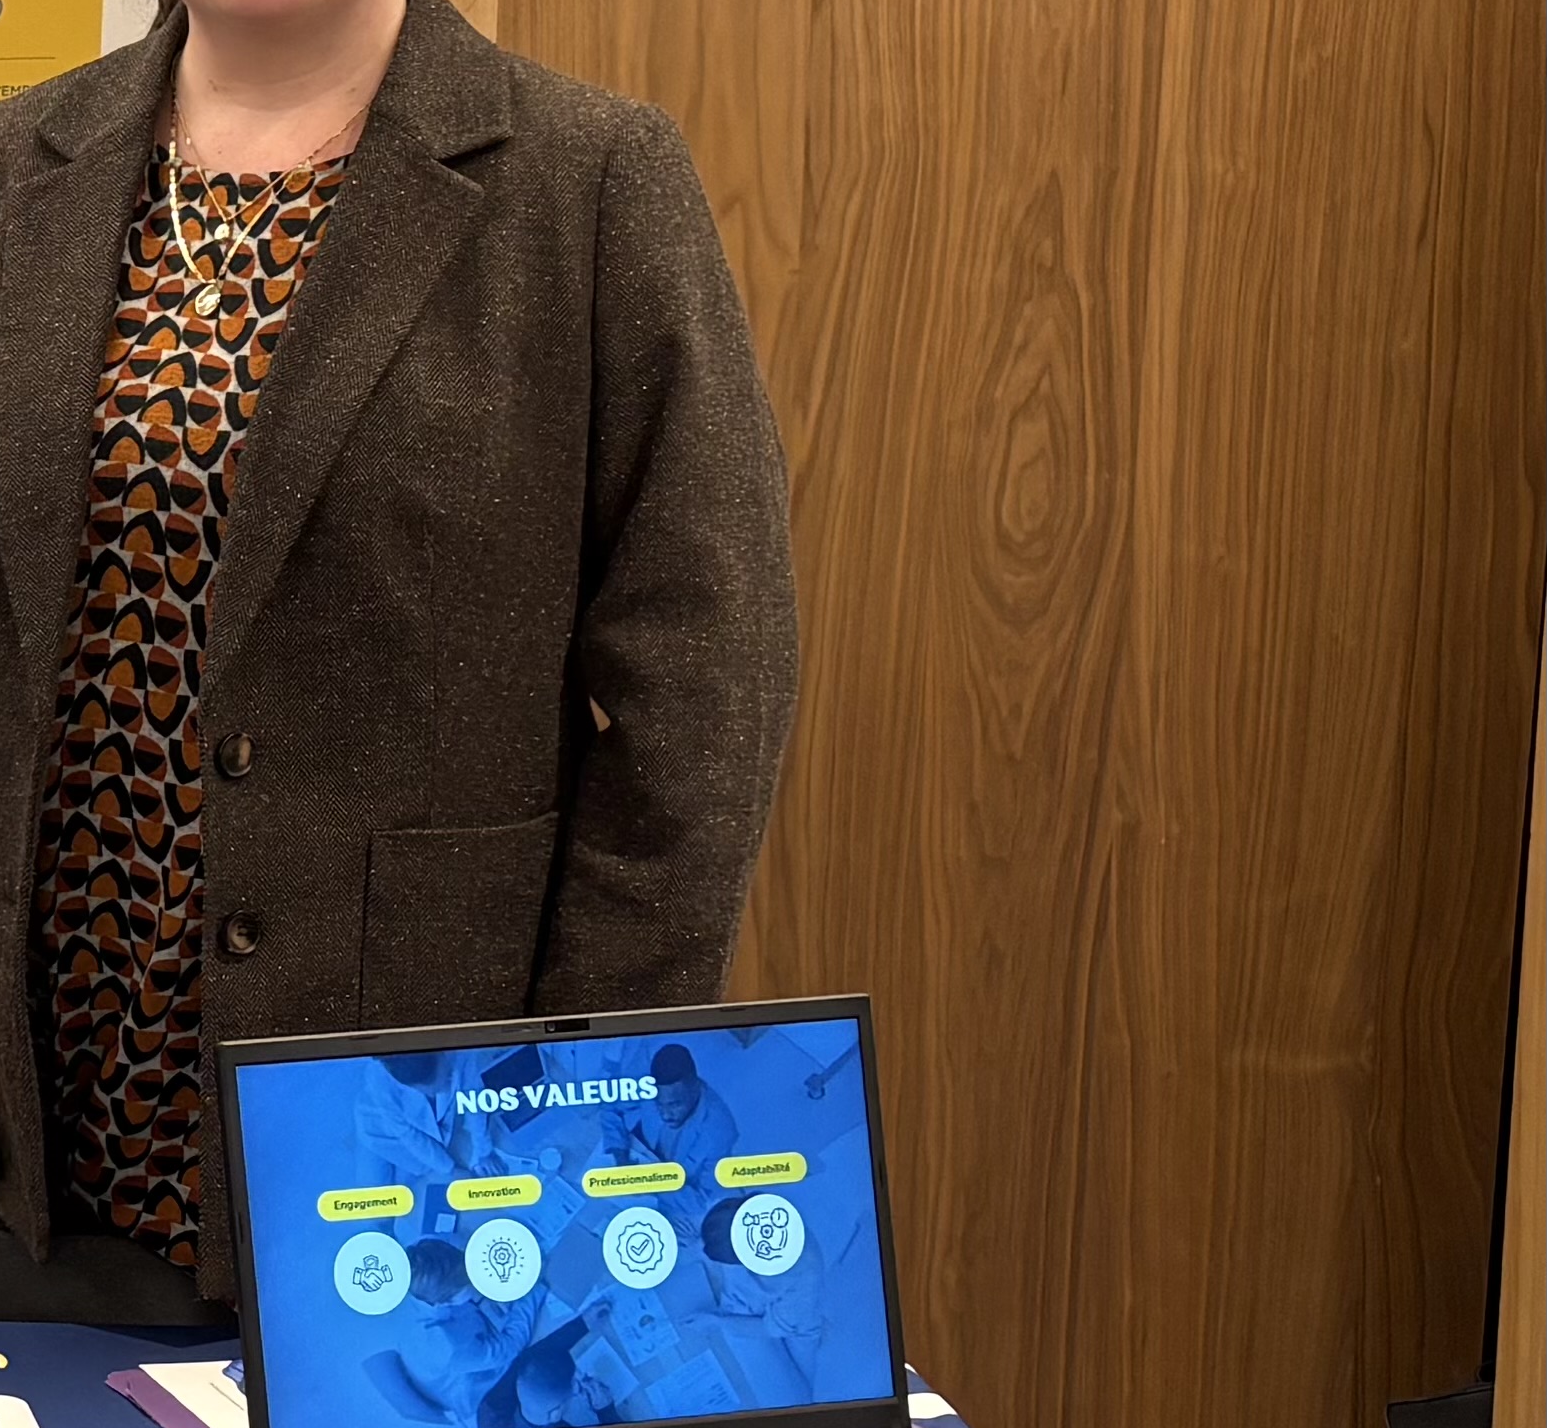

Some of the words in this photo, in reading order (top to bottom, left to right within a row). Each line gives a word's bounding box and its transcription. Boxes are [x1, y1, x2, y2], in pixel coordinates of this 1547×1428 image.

[456, 1087, 520, 1115] NOS
[522, 1075, 658, 1109] VALEURS
[731, 1162, 791, 1178] Adaptabilité
[588, 1172, 679, 1188] Professionnalisme
[468, 1186, 521, 1200] Innovation
[333, 1196, 398, 1212] Engagement
